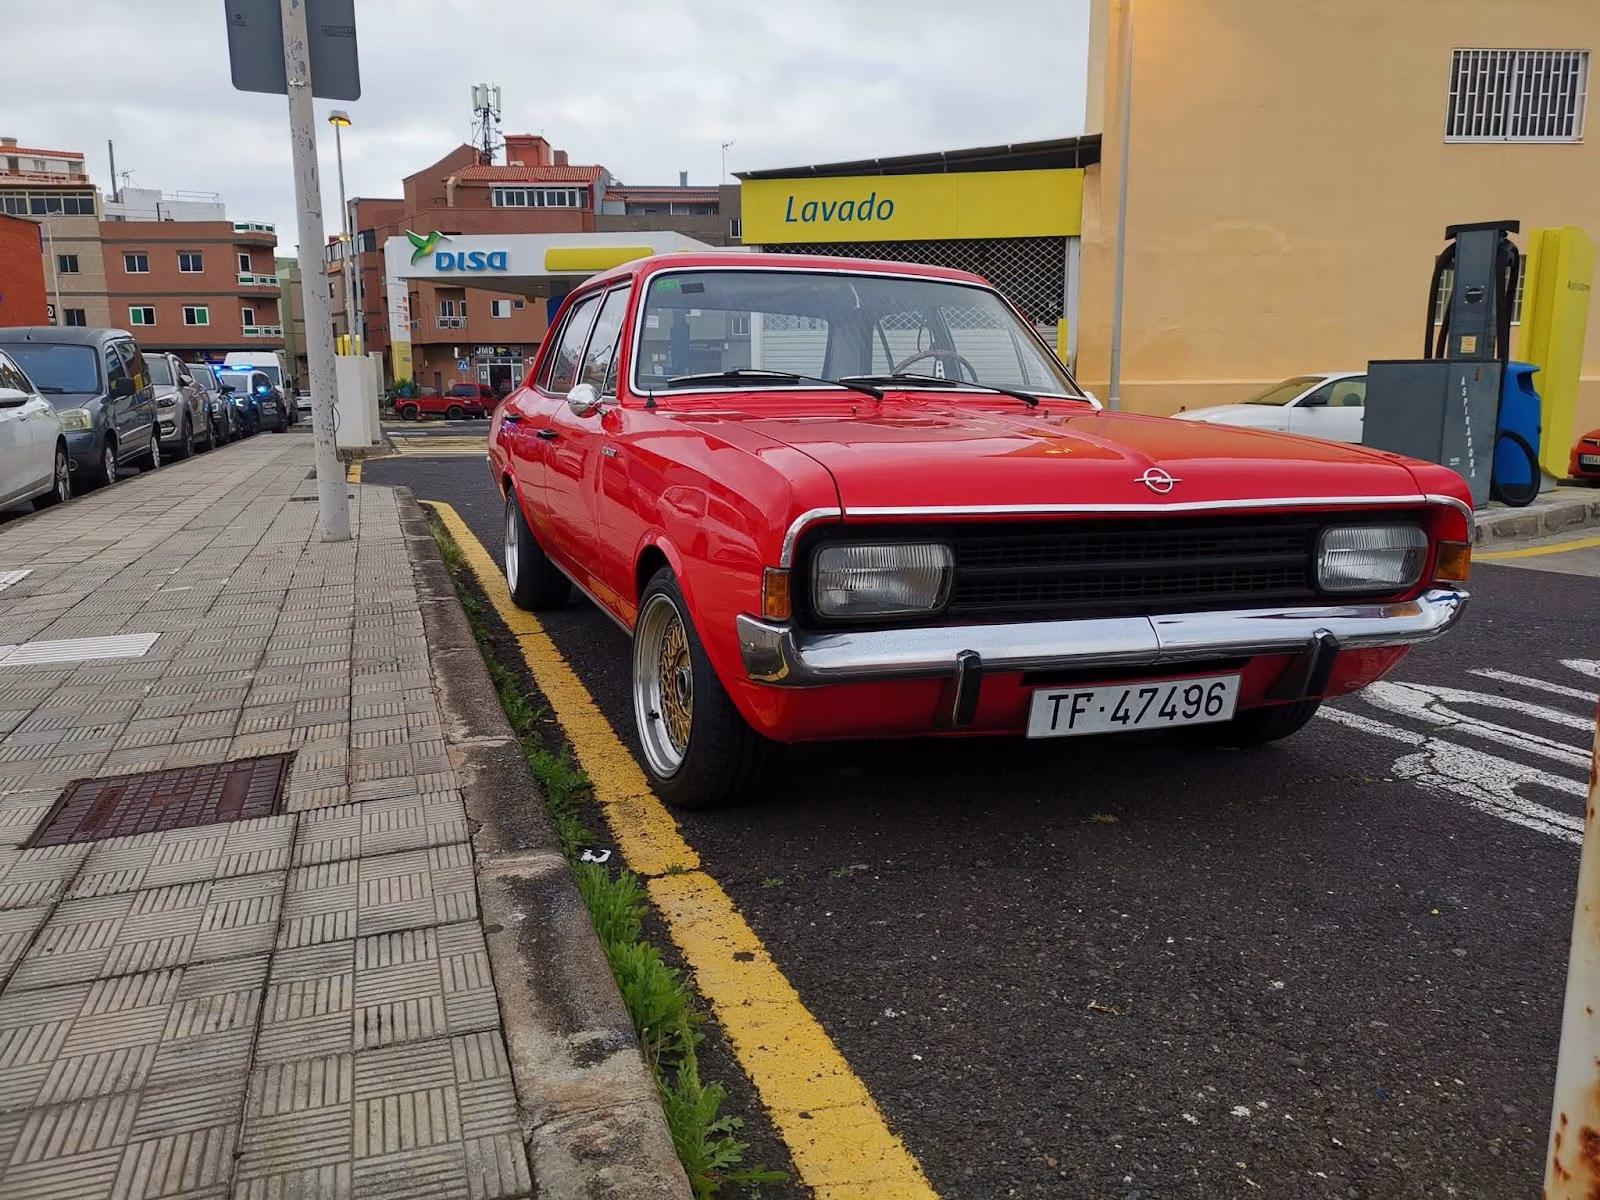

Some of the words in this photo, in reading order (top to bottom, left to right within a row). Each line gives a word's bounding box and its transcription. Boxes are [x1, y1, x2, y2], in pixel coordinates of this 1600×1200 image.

[785, 192, 895, 223] Lavado
[475, 346, 495, 354] JMD
[1460, 376, 1476, 478] ASPIRADORA
